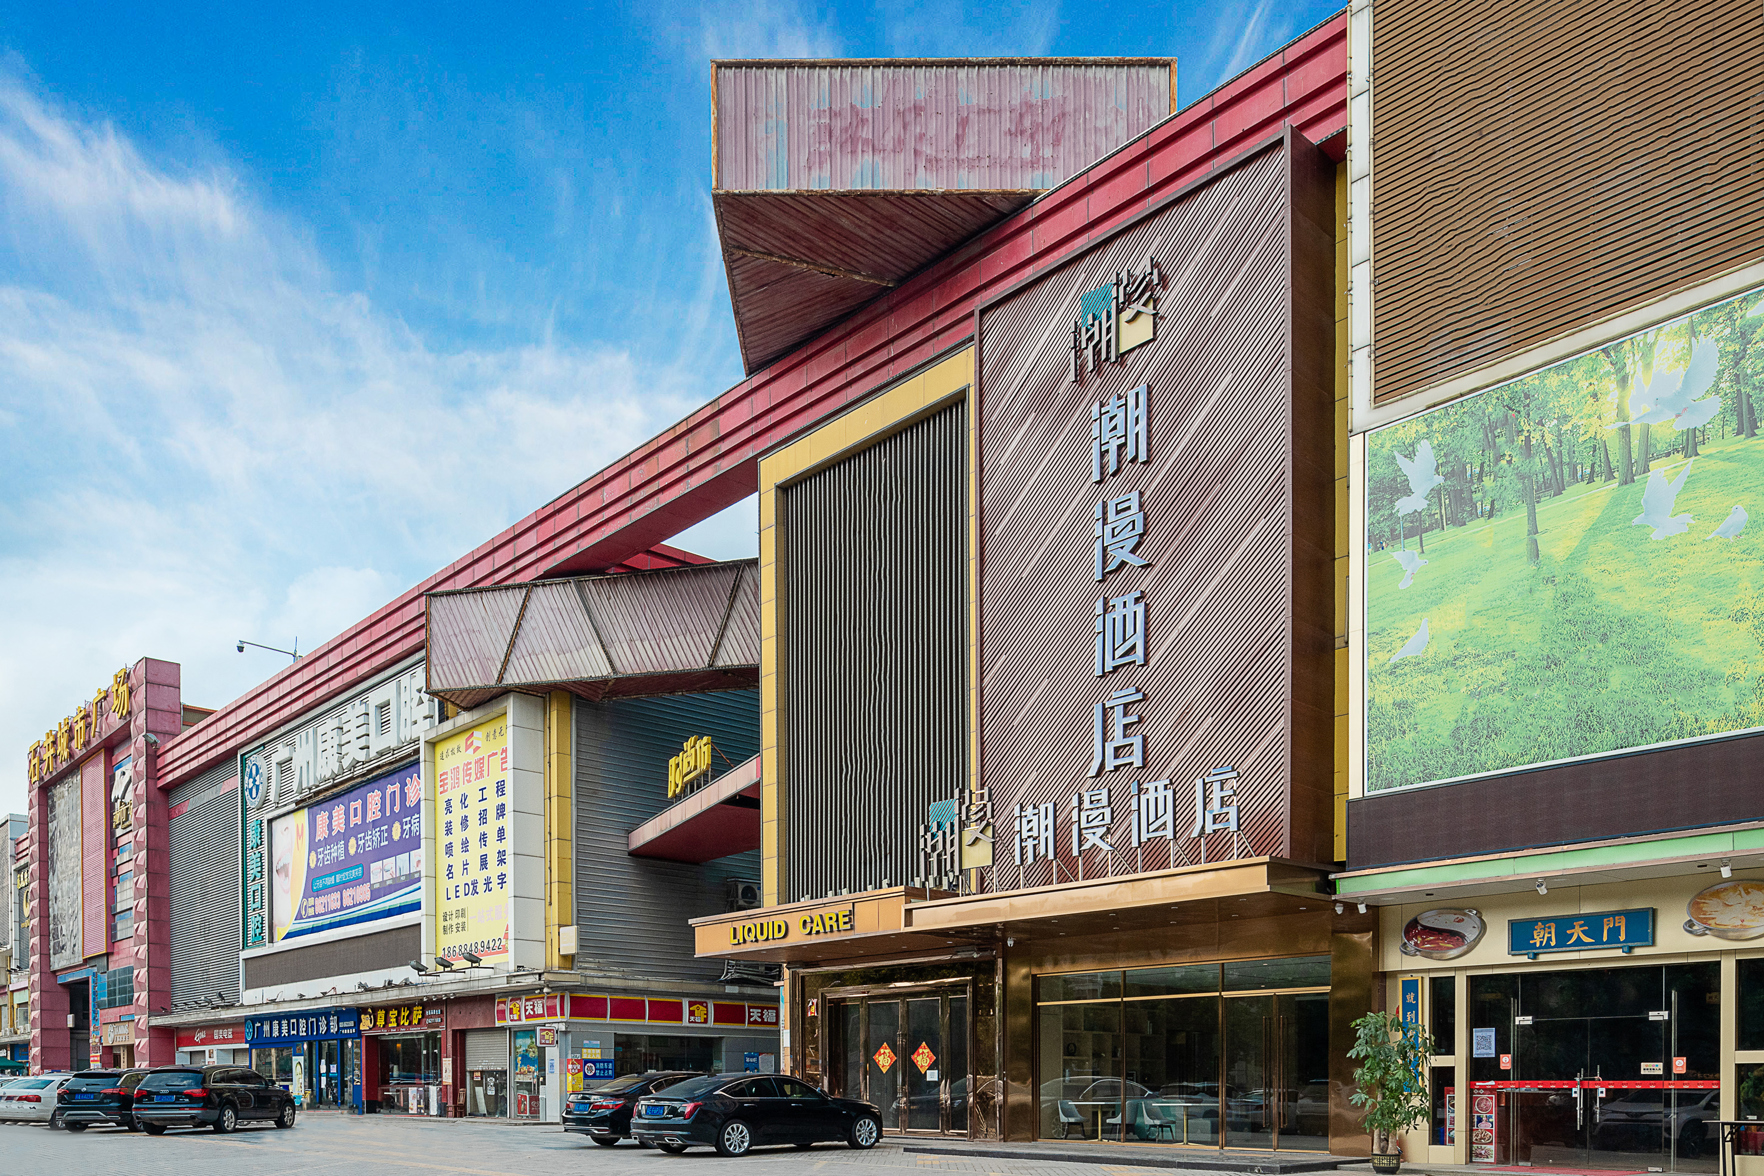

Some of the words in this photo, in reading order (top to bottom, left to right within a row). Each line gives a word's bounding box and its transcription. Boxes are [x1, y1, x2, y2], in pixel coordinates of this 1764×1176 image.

[1088, 383, 1151, 778] 潮漫酒店
[28, 668, 130, 784] 石井城市广场
[270, 665, 435, 803] 广州康美口腔
[486, 726, 507, 741] 创意无
[439, 747, 508, 795] 宝鸿传媒广告
[315, 773, 421, 842] 康美口腔门诊
[444, 779, 506, 815] 亮化工程
[444, 802, 506, 837] 装修招牌
[1014, 765, 1240, 867] 潮漫酒店
[317, 840, 345, 867] 牙齿种植
[357, 825, 389, 854] 牙齿矫正
[444, 825, 506, 858] 喷绘传单
[249, 819, 263, 943] 康美口腔
[446, 849, 506, 880] 名片展架
[730, 920, 787, 945] LIQUID
[799, 910, 853, 935] CARE
[1530, 916, 1626, 947] 朝天門
[442, 938, 502, 959] 18688489422
[376, 1006, 422, 1028] 尊宝比萨
[525, 999, 544, 1015] 天福
[749, 1008, 777, 1023] 天福
[254, 1015, 339, 1039] 广州康美口腔门诊部
[878, 1049, 891, 1066] 福
[917, 1049, 930, 1066] 福
